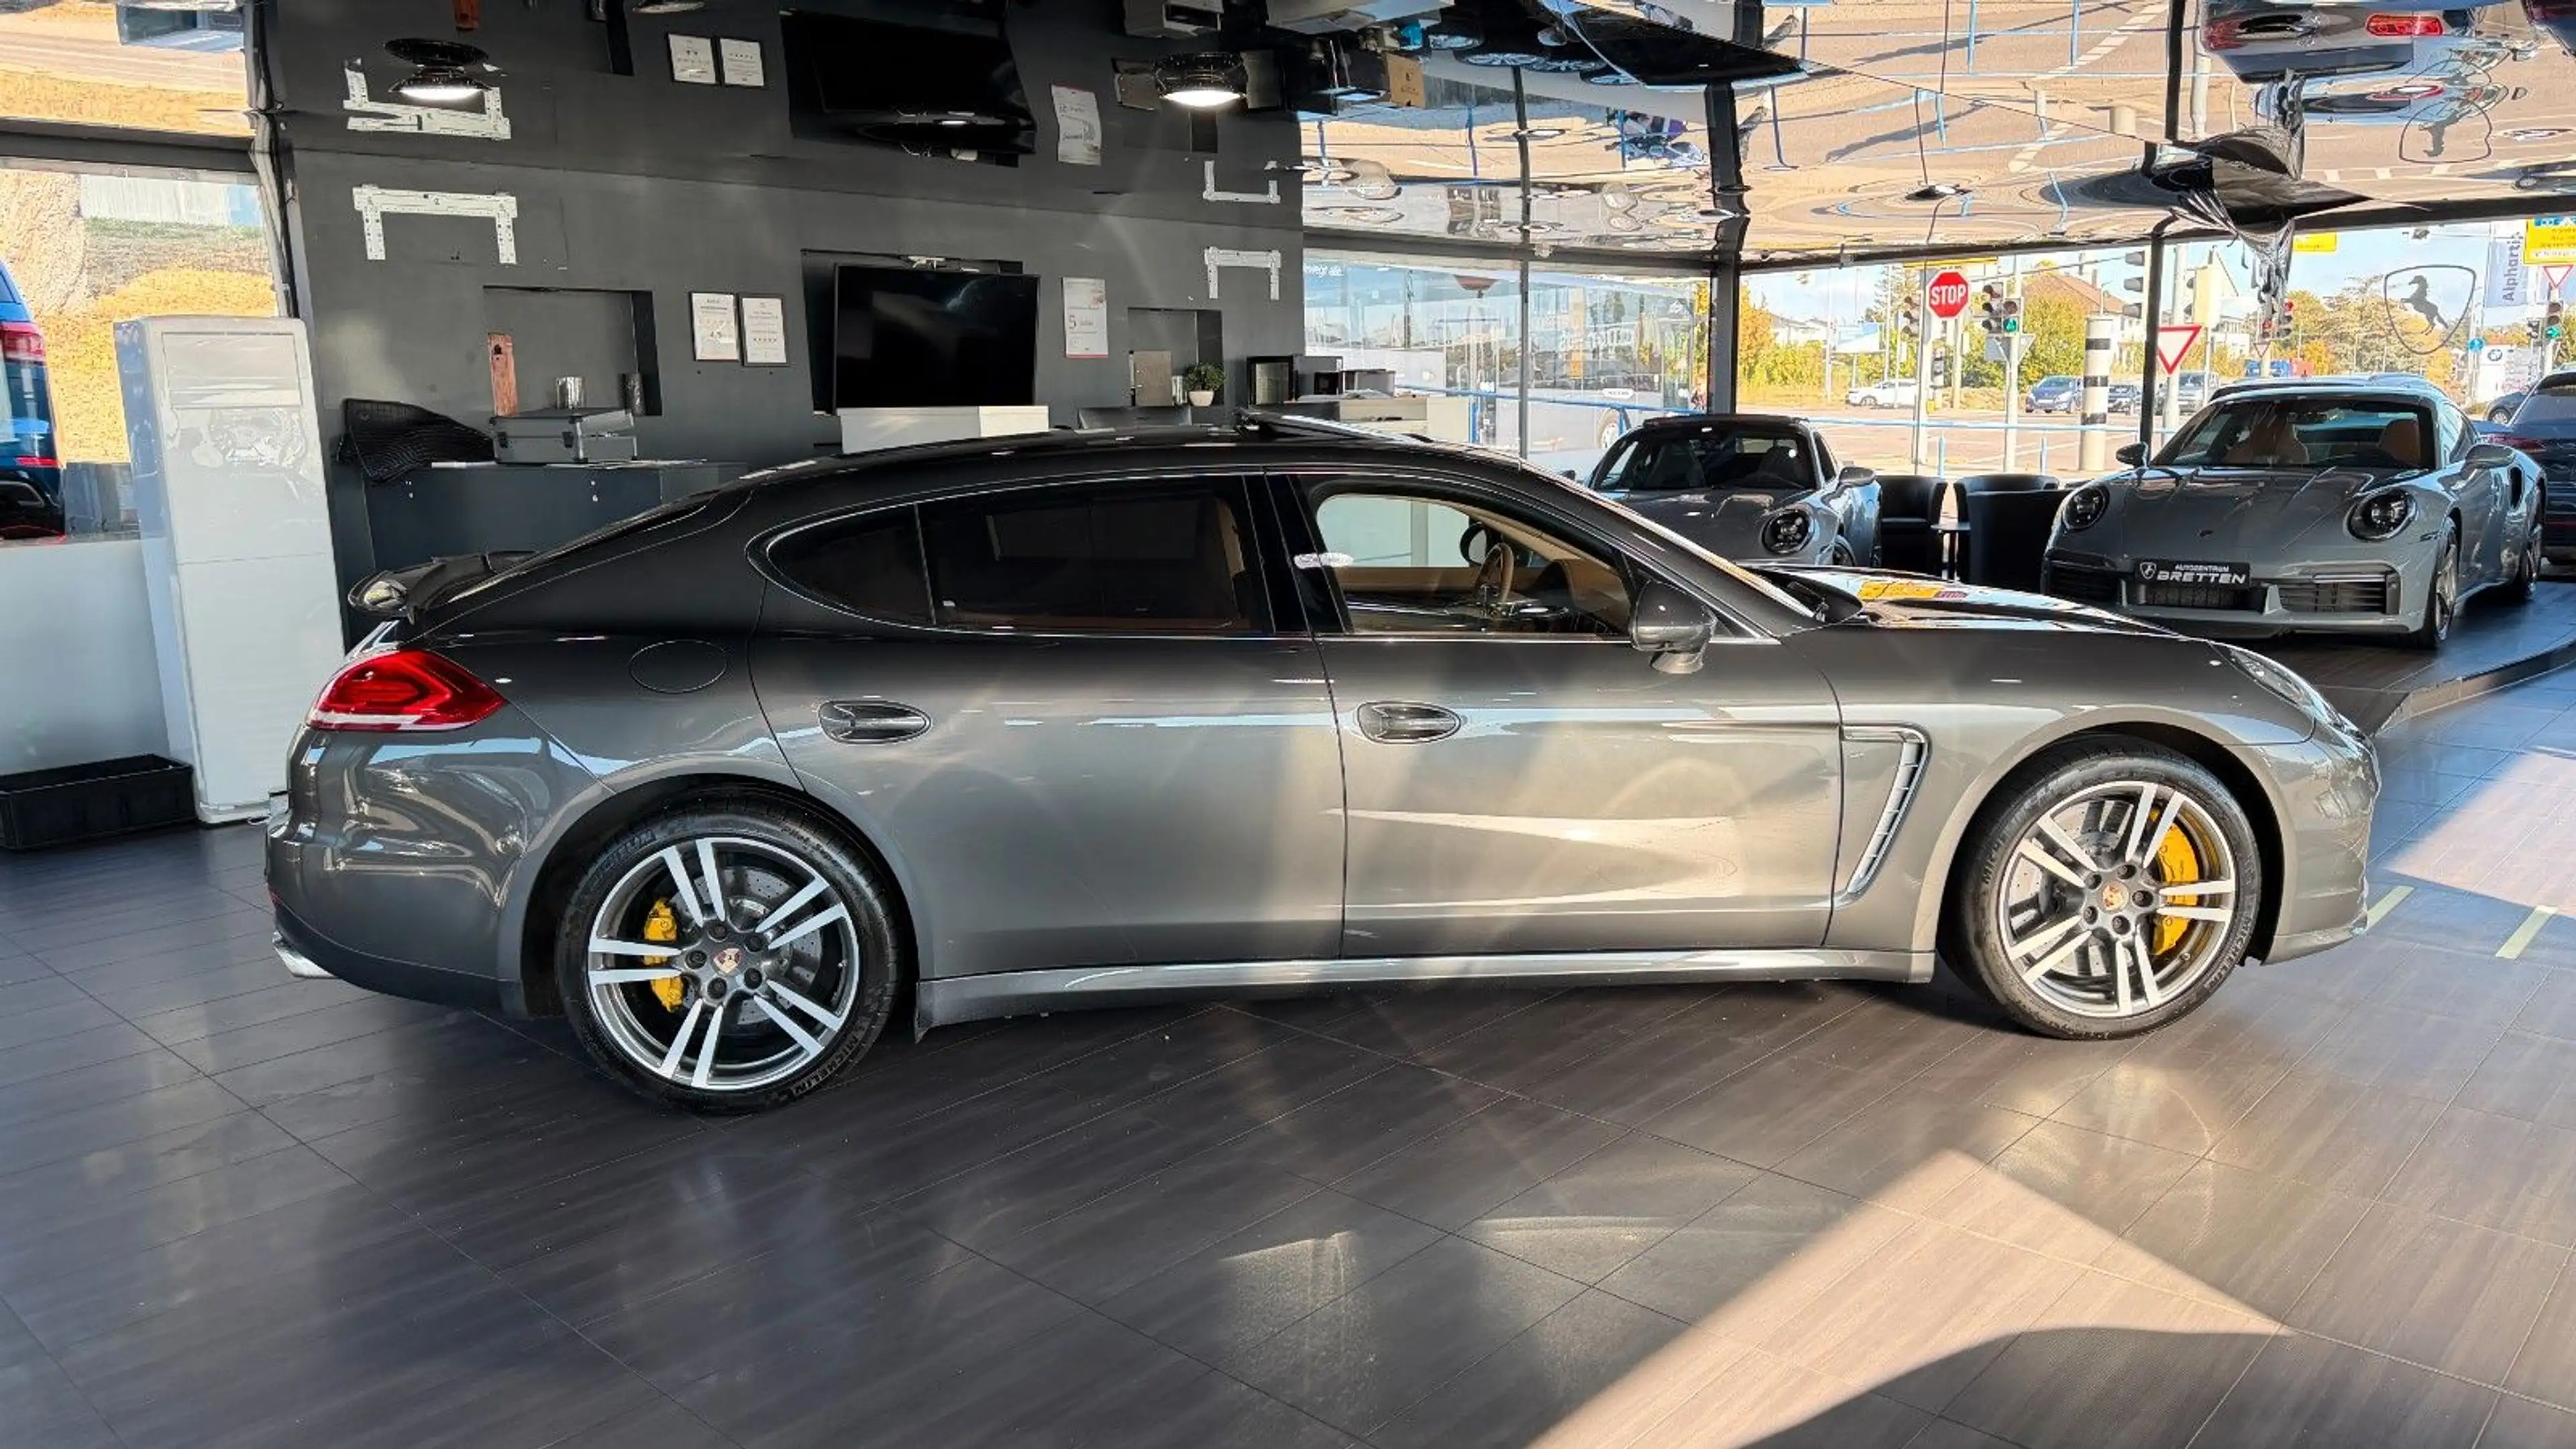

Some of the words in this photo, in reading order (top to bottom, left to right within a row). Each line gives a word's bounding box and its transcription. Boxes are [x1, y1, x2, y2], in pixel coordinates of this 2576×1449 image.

[1931, 284, 1966, 305] STOP
[2175, 564, 2229, 572] AUTOZENTRUM
[2157, 571, 2246, 584] BRETTEN
[790, 1036, 862, 1095] MICHELIN
